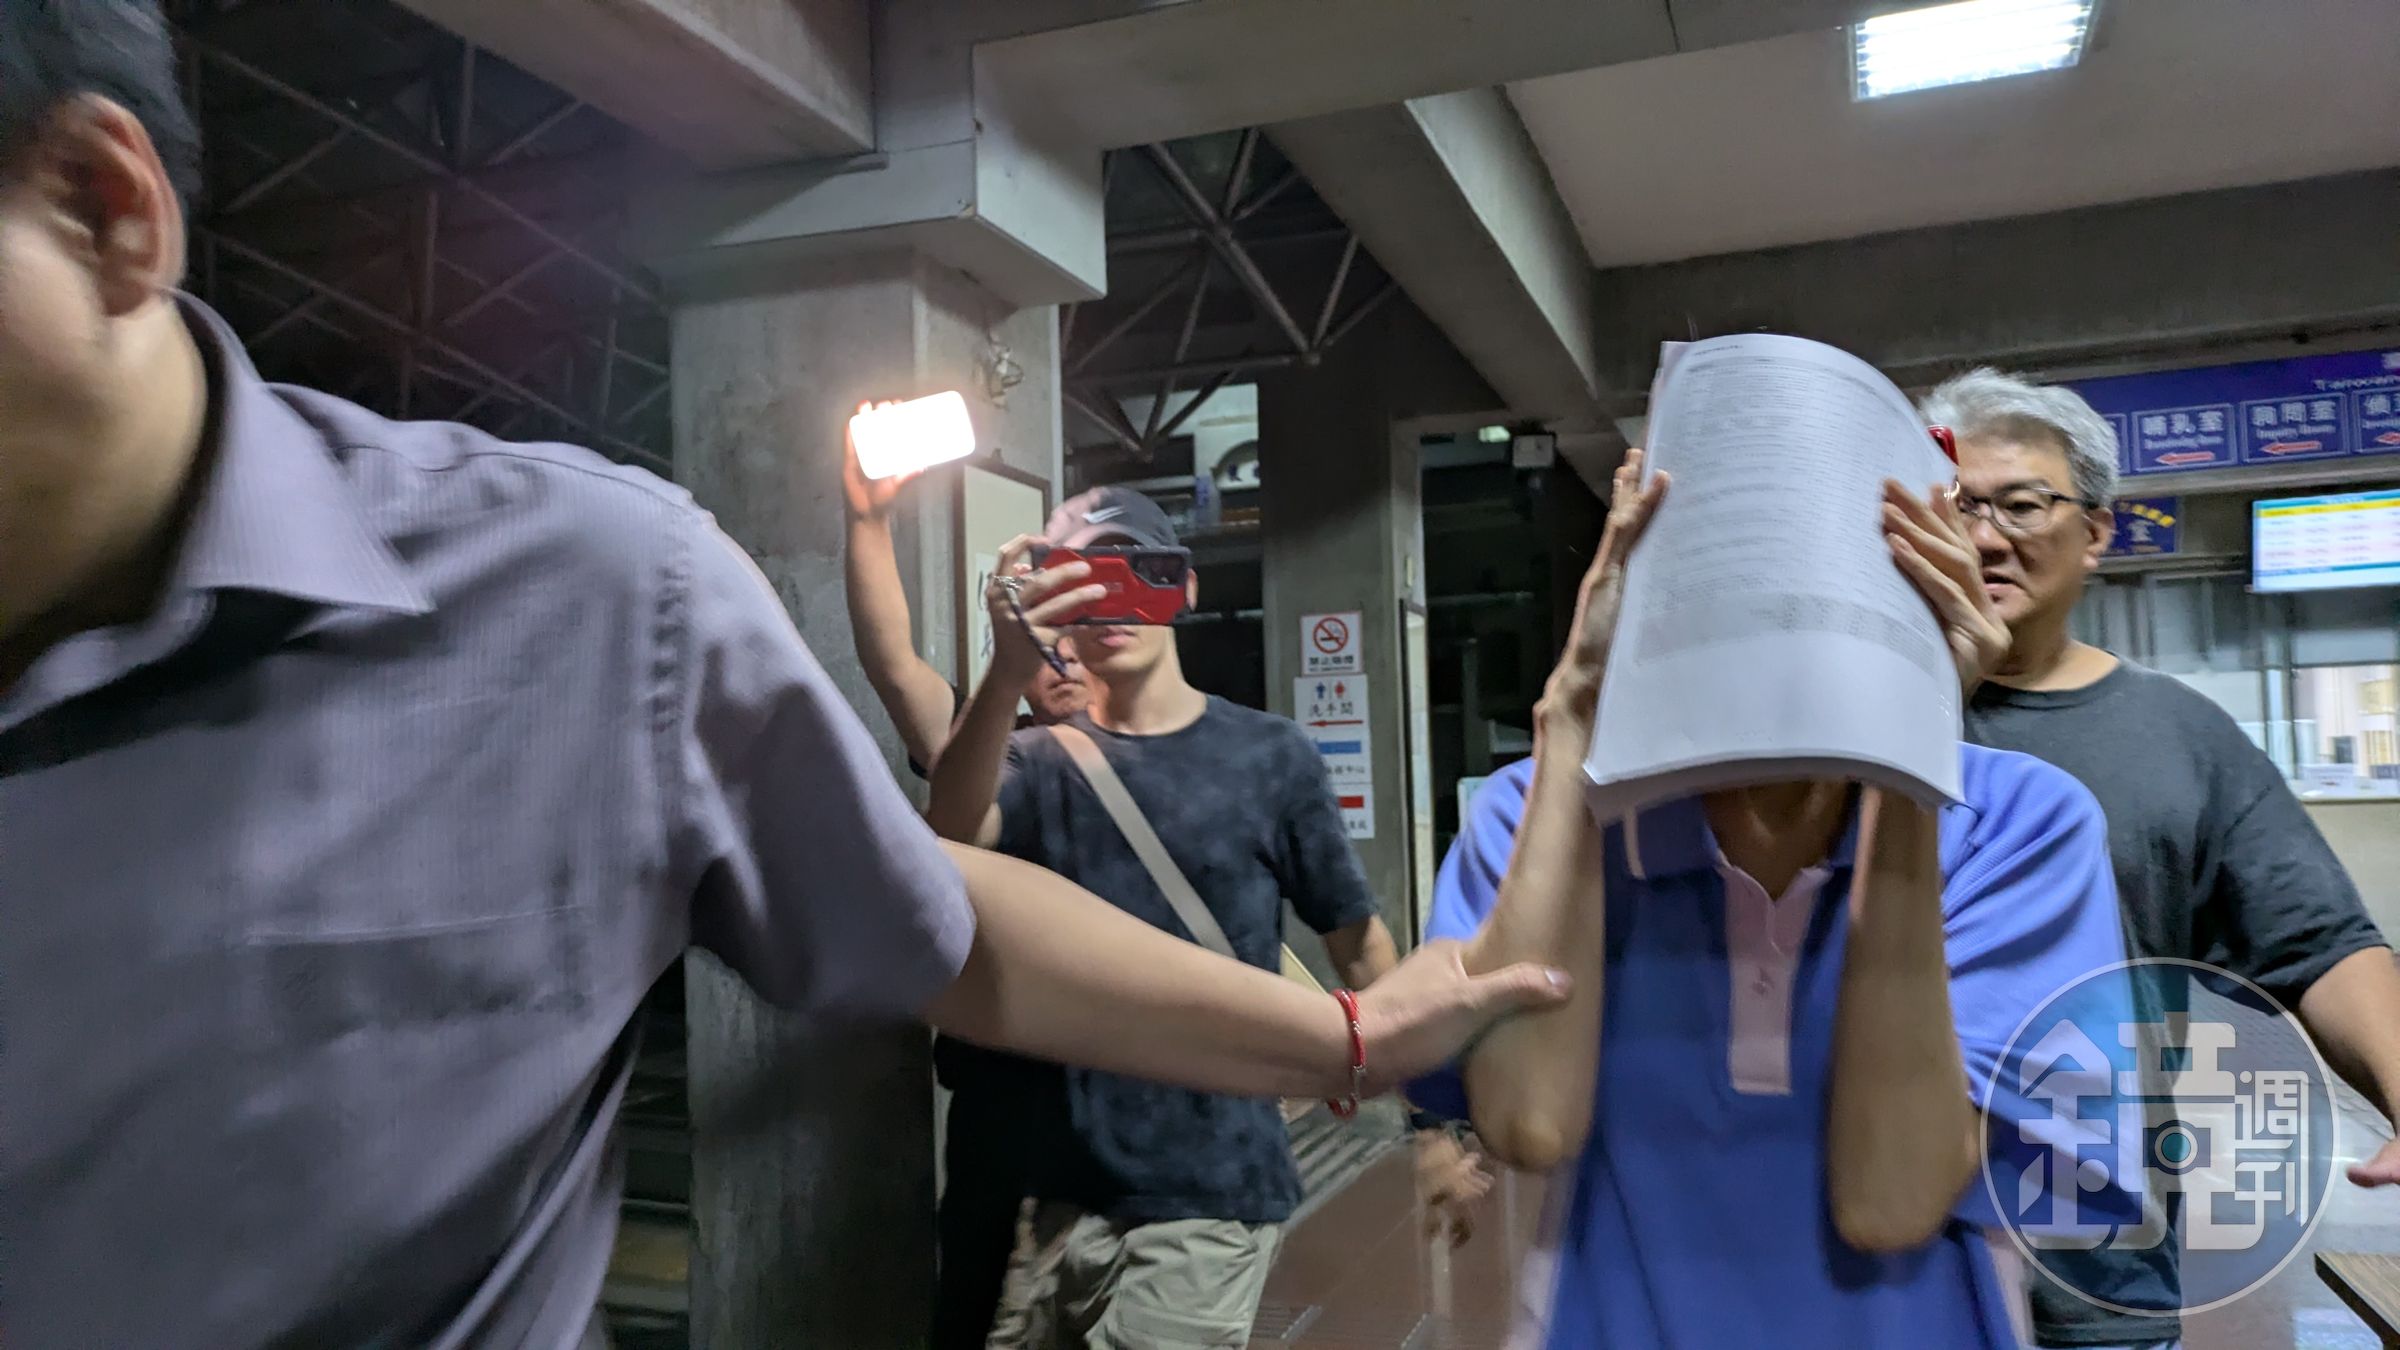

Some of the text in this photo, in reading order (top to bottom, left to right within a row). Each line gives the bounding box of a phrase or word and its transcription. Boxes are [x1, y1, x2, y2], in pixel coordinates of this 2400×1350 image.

[2142, 410, 2224, 436] 哺乳室
[1309, 700, 1354, 718] 洗手間
